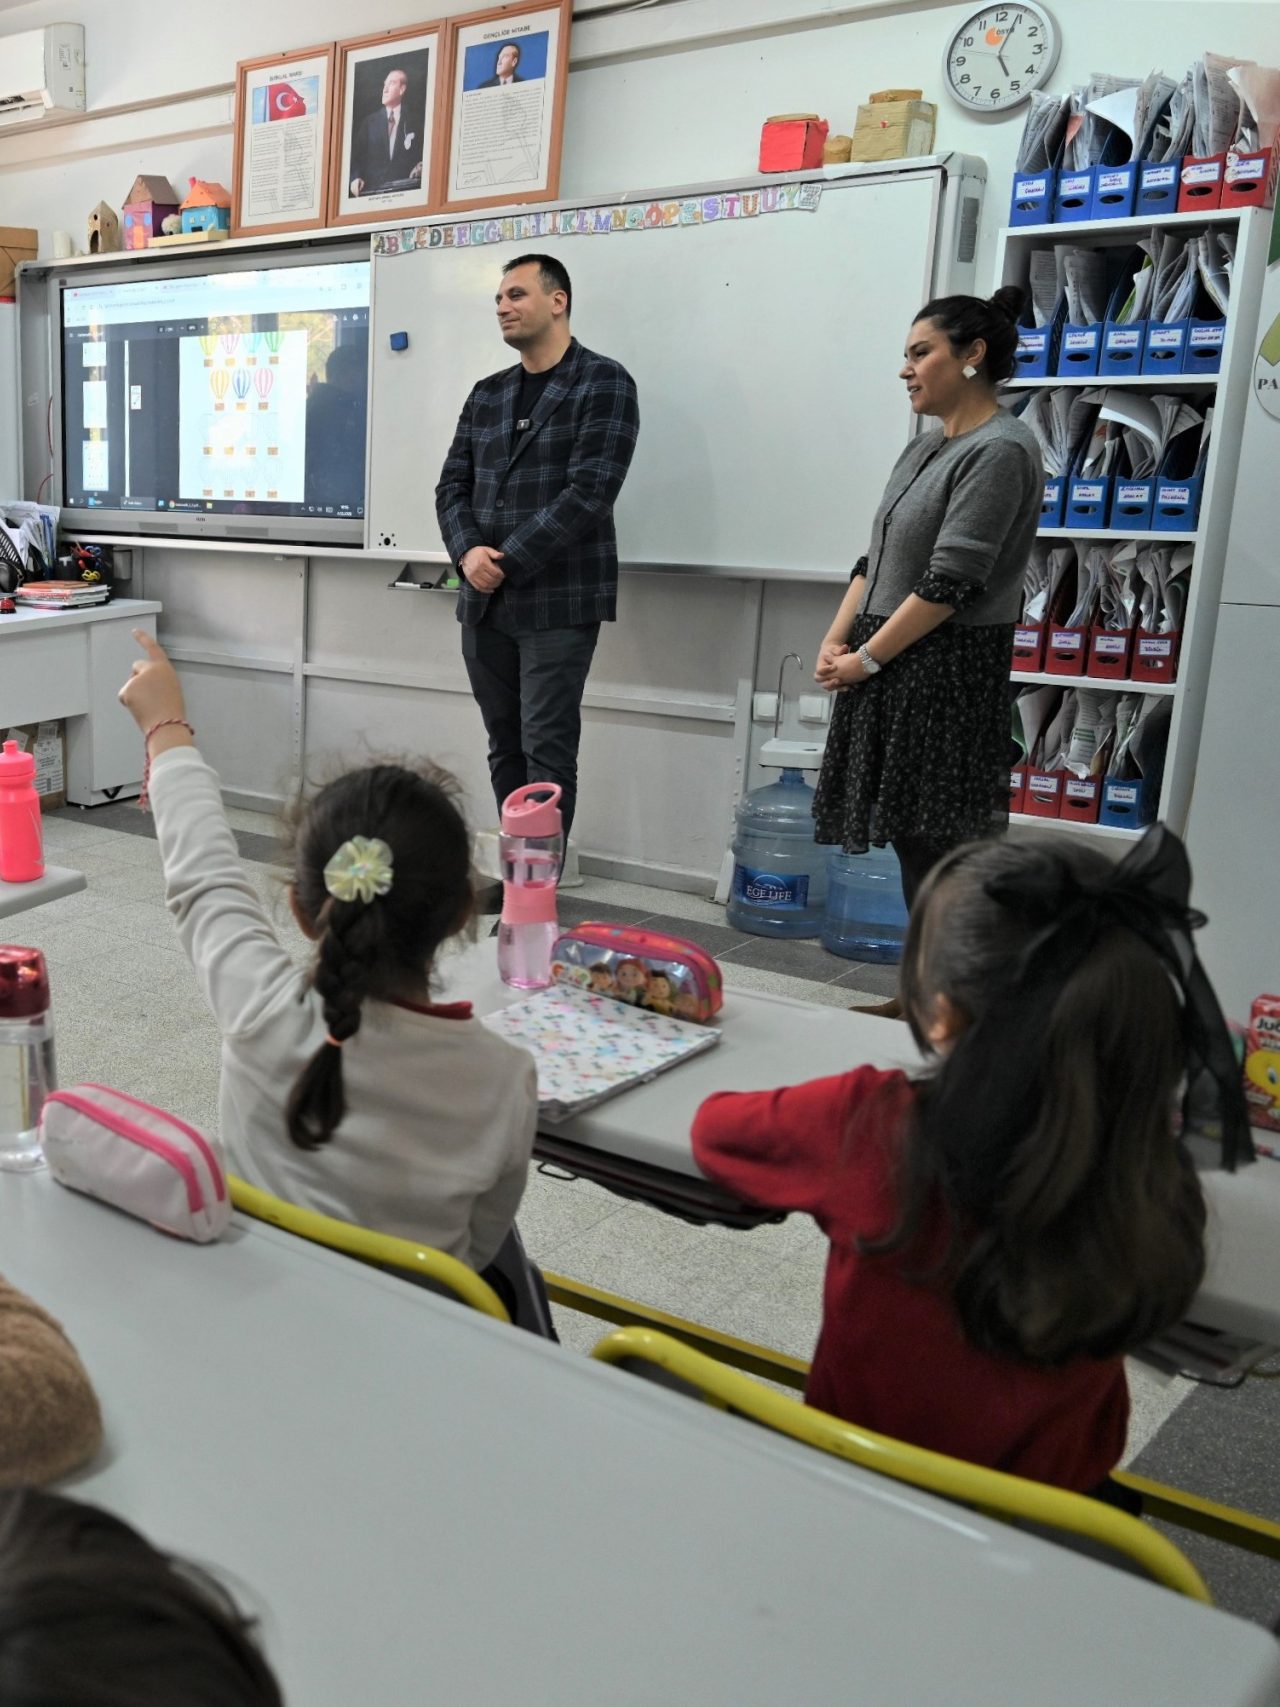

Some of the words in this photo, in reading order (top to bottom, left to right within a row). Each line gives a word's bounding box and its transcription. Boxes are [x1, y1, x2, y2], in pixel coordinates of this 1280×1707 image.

[996, 12, 1008, 22] 12
[1018, 14, 1022, 24] 1
[979, 20, 986, 30] 11
[1028, 26, 1038, 37] 2
[964, 37, 974, 47] 10
[1032, 44, 1043, 55] 3
[956, 56, 966, 66] 9
[1025, 64, 1035, 74] 4
[960, 74, 970, 84] 8
[1010, 80, 1020, 90] 5
[973, 86, 982, 96] 7
[990, 89, 1000, 98] 6
[746, 885, 766, 898] EGE
[769, 889, 792, 900] LIFE
